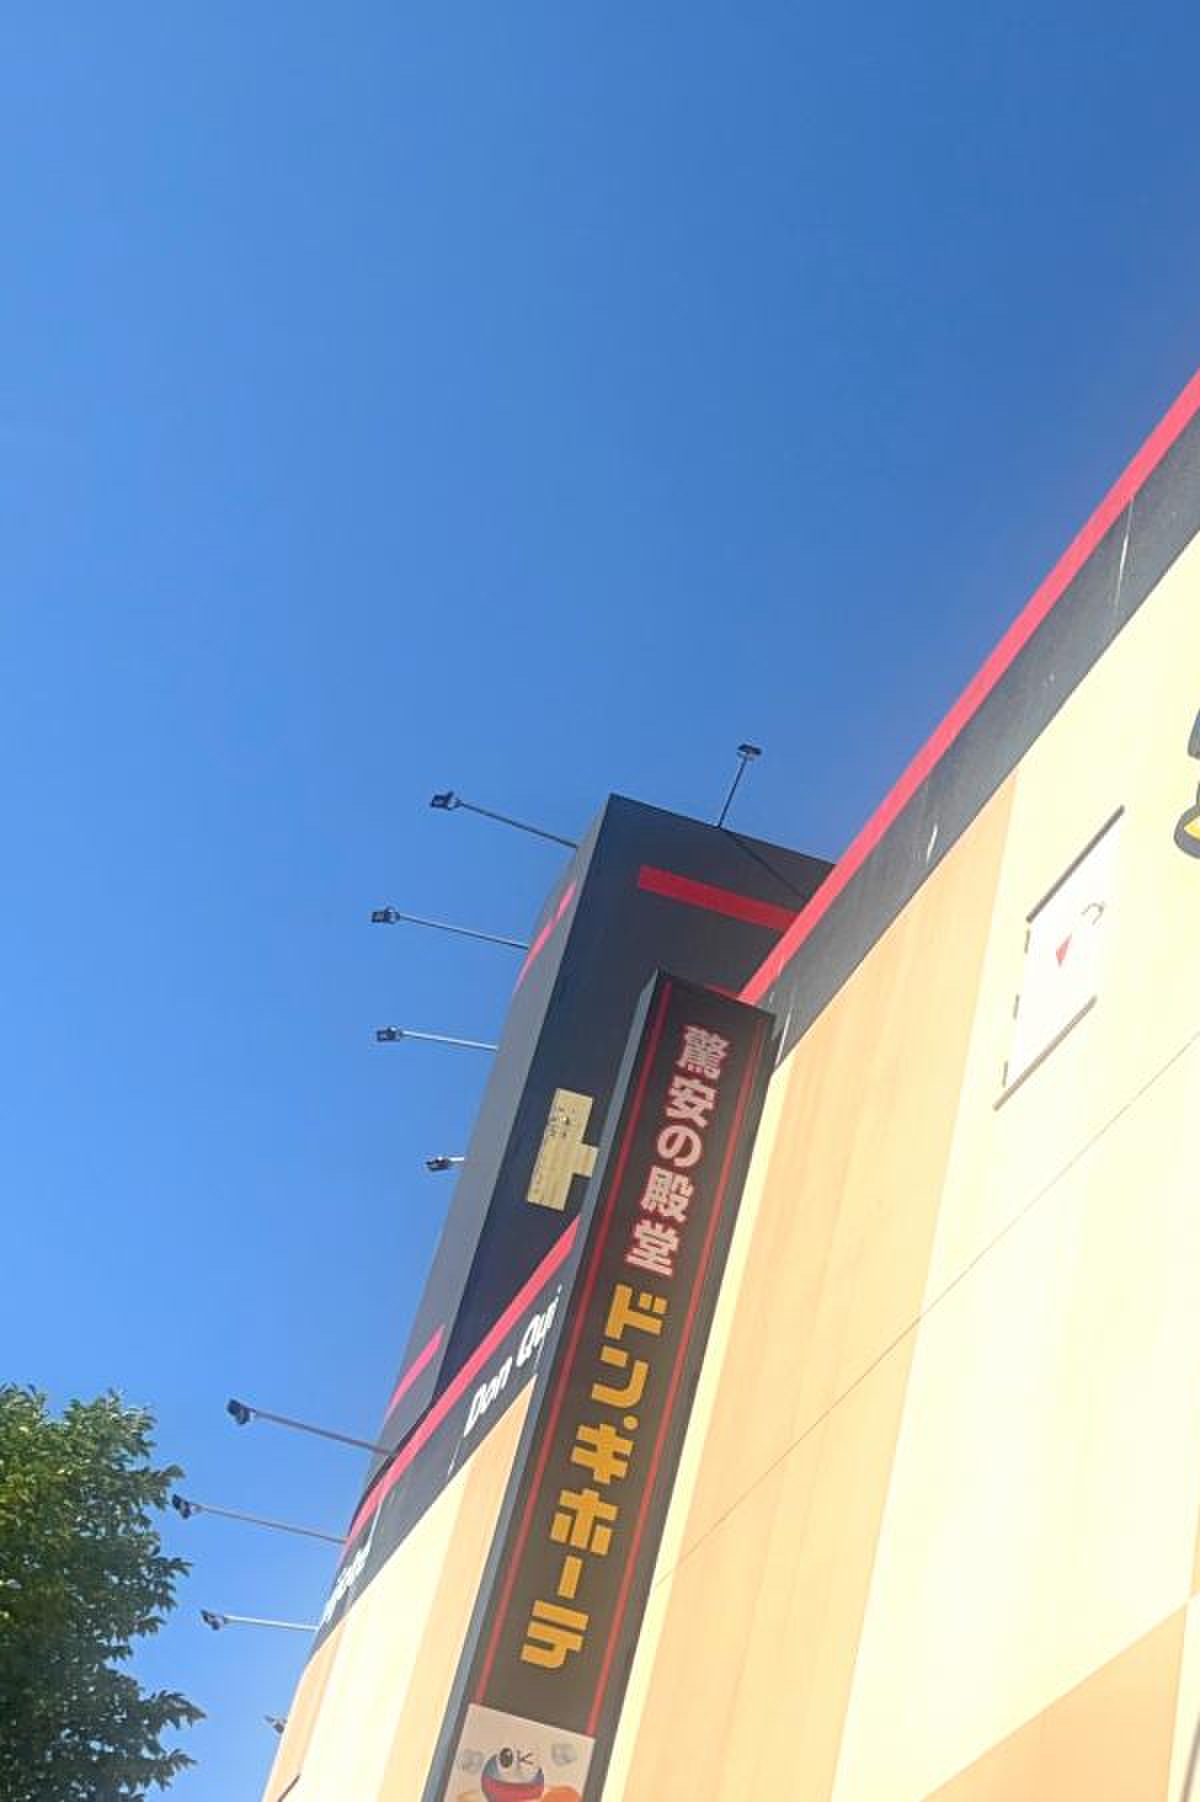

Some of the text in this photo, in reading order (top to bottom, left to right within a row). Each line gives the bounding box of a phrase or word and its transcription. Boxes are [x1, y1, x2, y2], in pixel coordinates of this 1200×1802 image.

[624, 1024, 732, 1276] 驚安の殿堂
